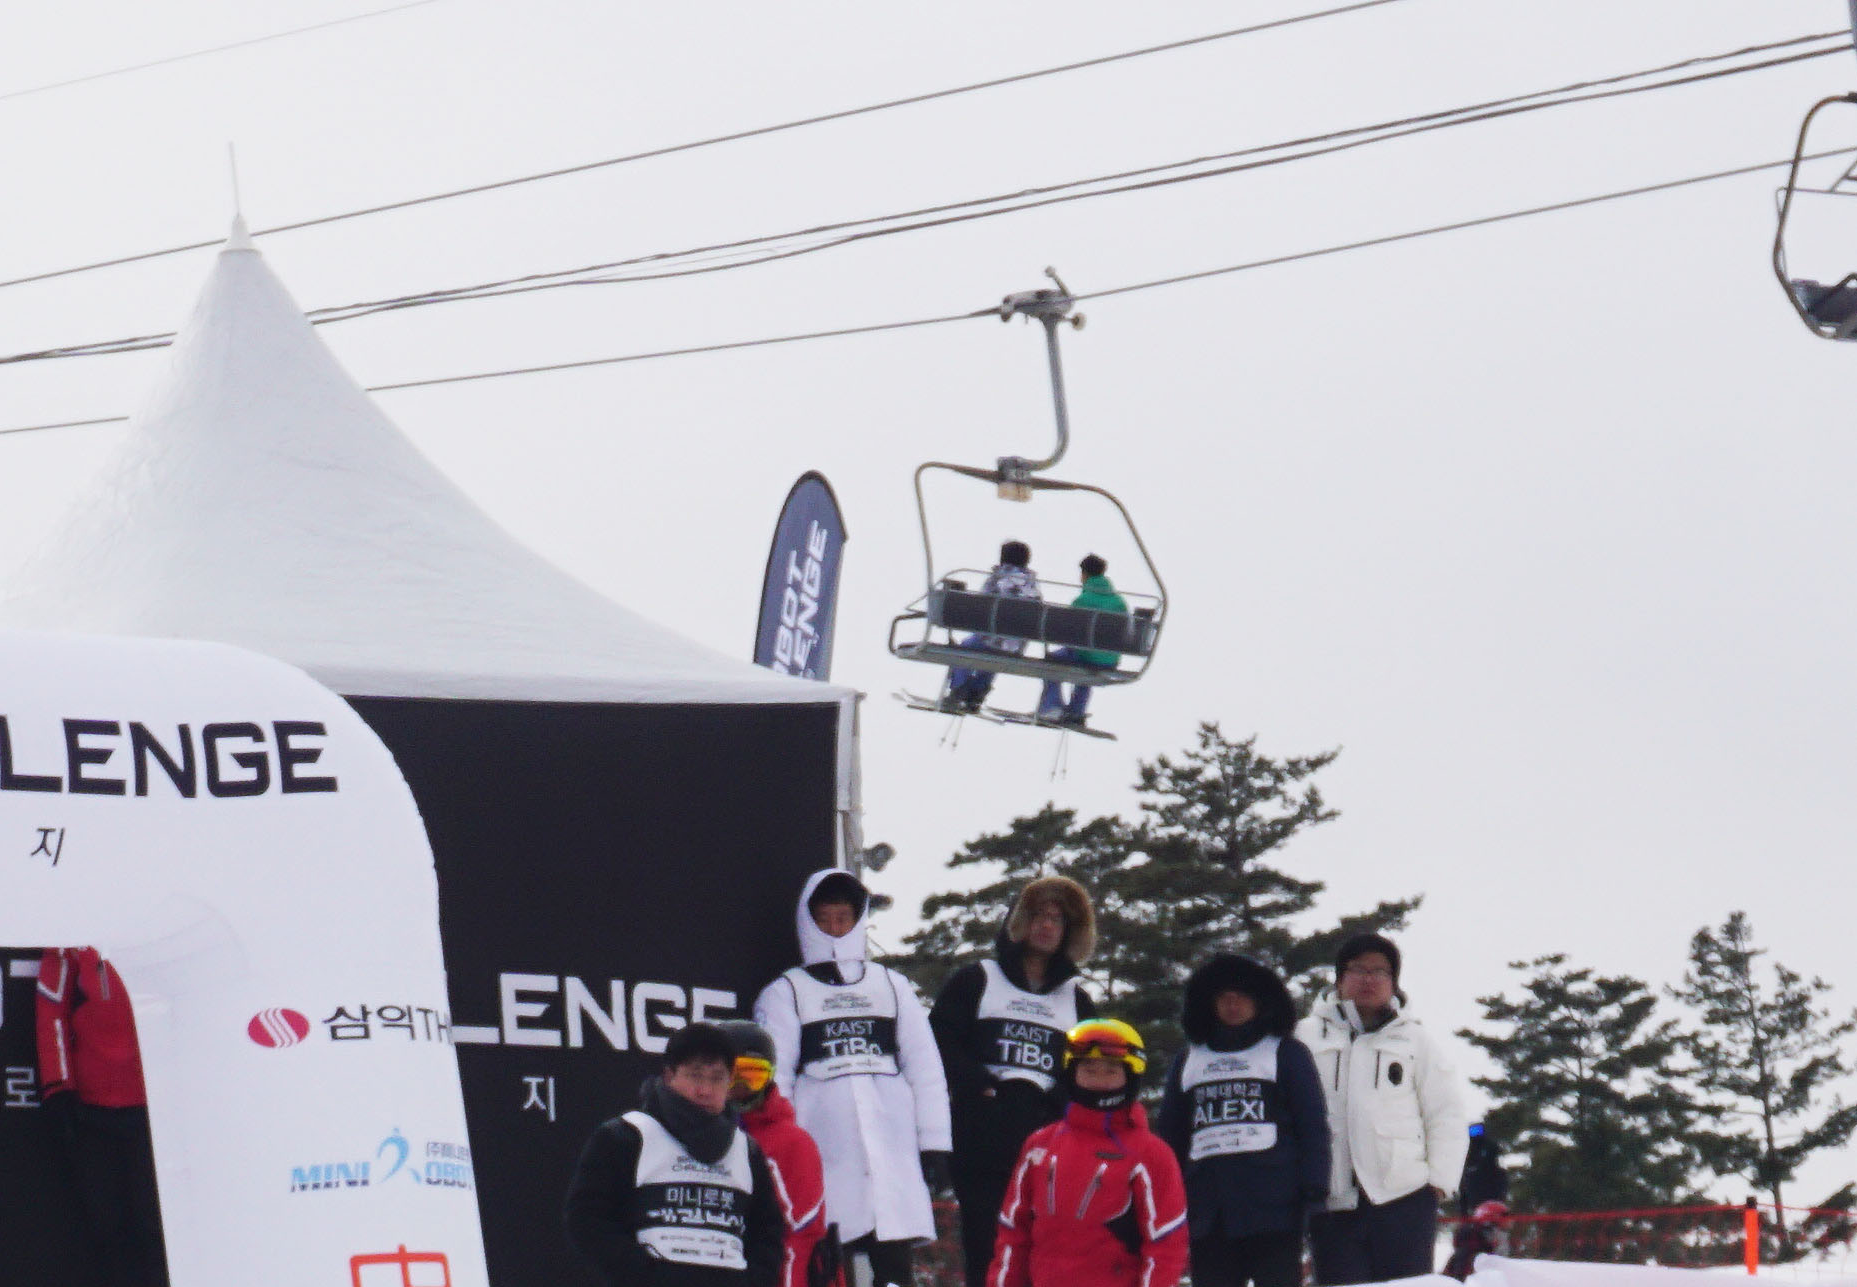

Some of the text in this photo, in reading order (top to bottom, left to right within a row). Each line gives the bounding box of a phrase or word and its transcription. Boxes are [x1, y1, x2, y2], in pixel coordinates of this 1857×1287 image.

[774, 551, 803, 674] BOT
[793, 520, 828, 677] ENGE
[996, 1038, 1054, 1071] TiBo
[1193, 1100, 1265, 1128] ALEXI
